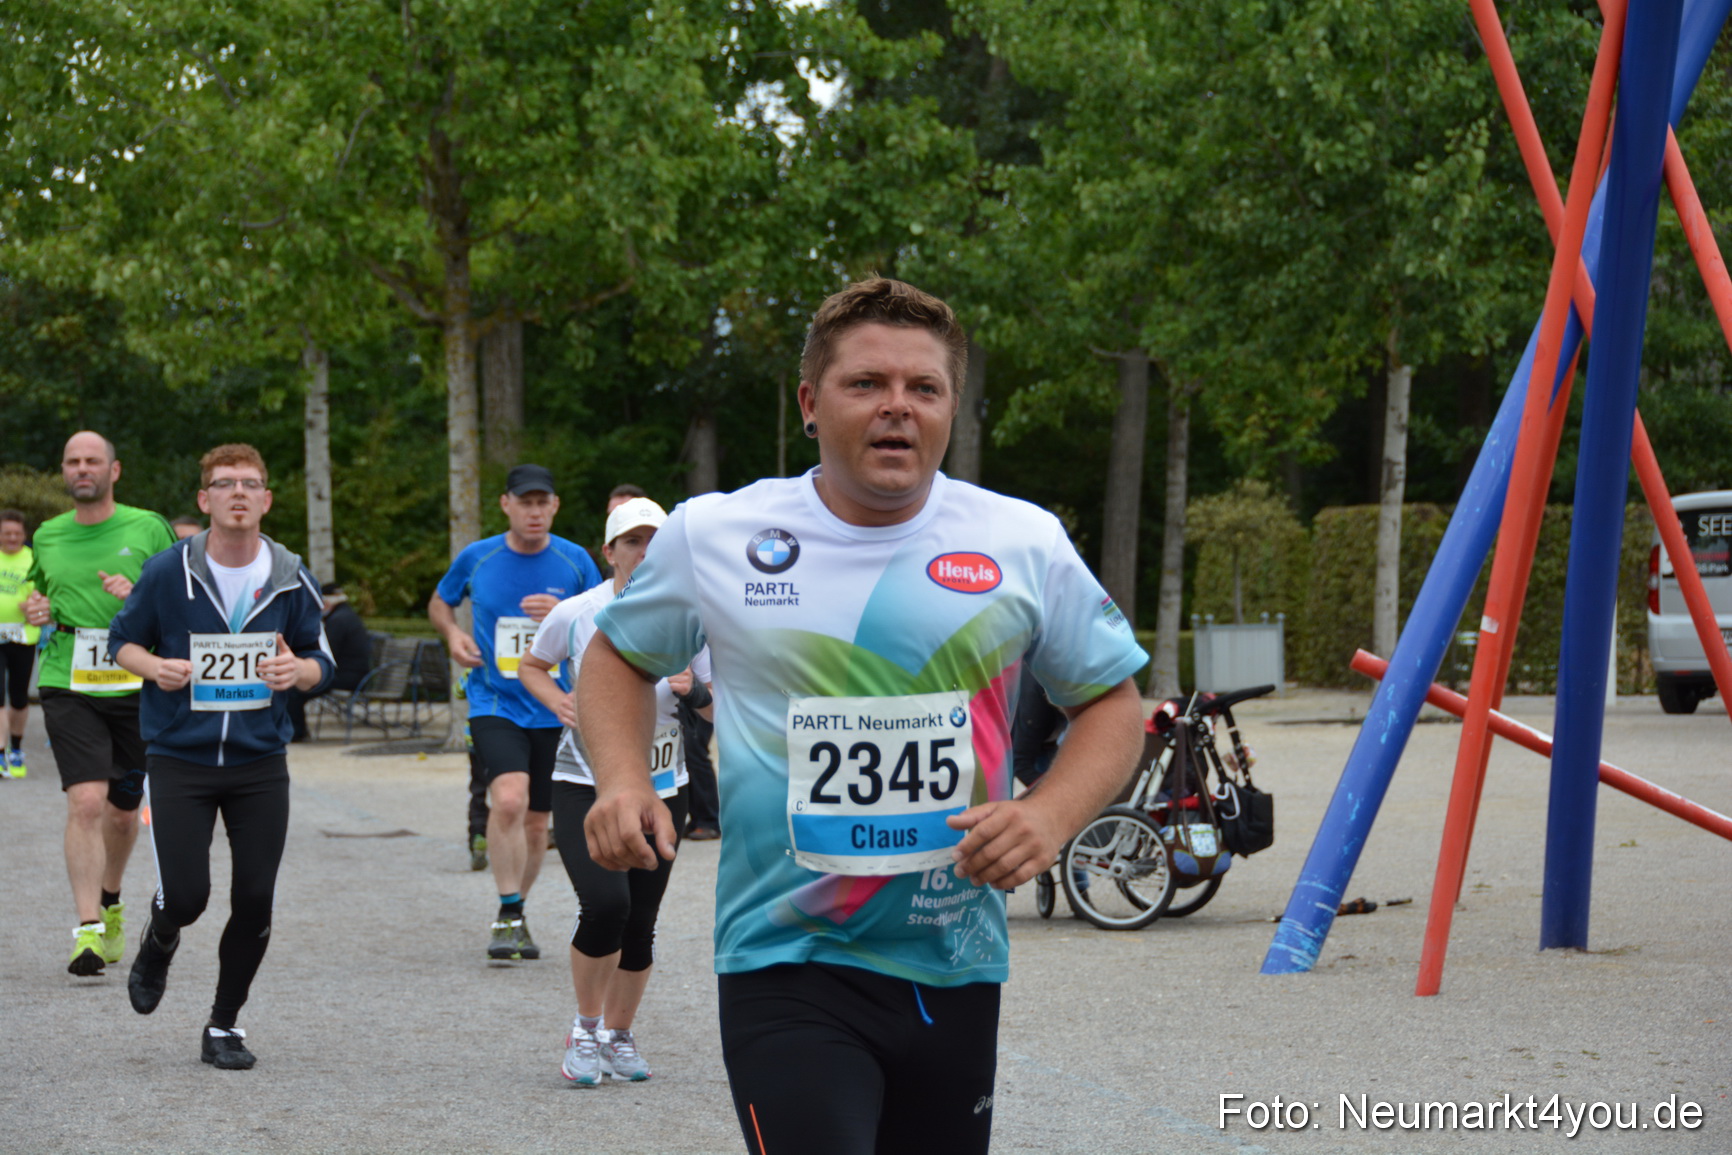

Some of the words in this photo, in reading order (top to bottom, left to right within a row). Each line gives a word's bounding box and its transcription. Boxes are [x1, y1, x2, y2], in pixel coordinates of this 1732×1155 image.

[751, 529, 798, 547] BMW
[938, 560, 995, 584] Hervis
[942, 577, 971, 585] SPORTS
[745, 582, 800, 596] PARTL
[745, 596, 800, 607] Neumarkt
[224, 640, 264, 649] Neumarkt
[88, 644, 114, 667] 14
[215, 688, 255, 699] Markus
[792, 715, 853, 730] PARTL
[858, 713, 943, 730] Neumarkt
[809, 738, 960, 806] 2345
[851, 824, 918, 849] Claus
[920, 867, 953, 891] 16.
[911, 888, 984, 909] Neumarkter
[907, 906, 967, 927] Stadtlauf
